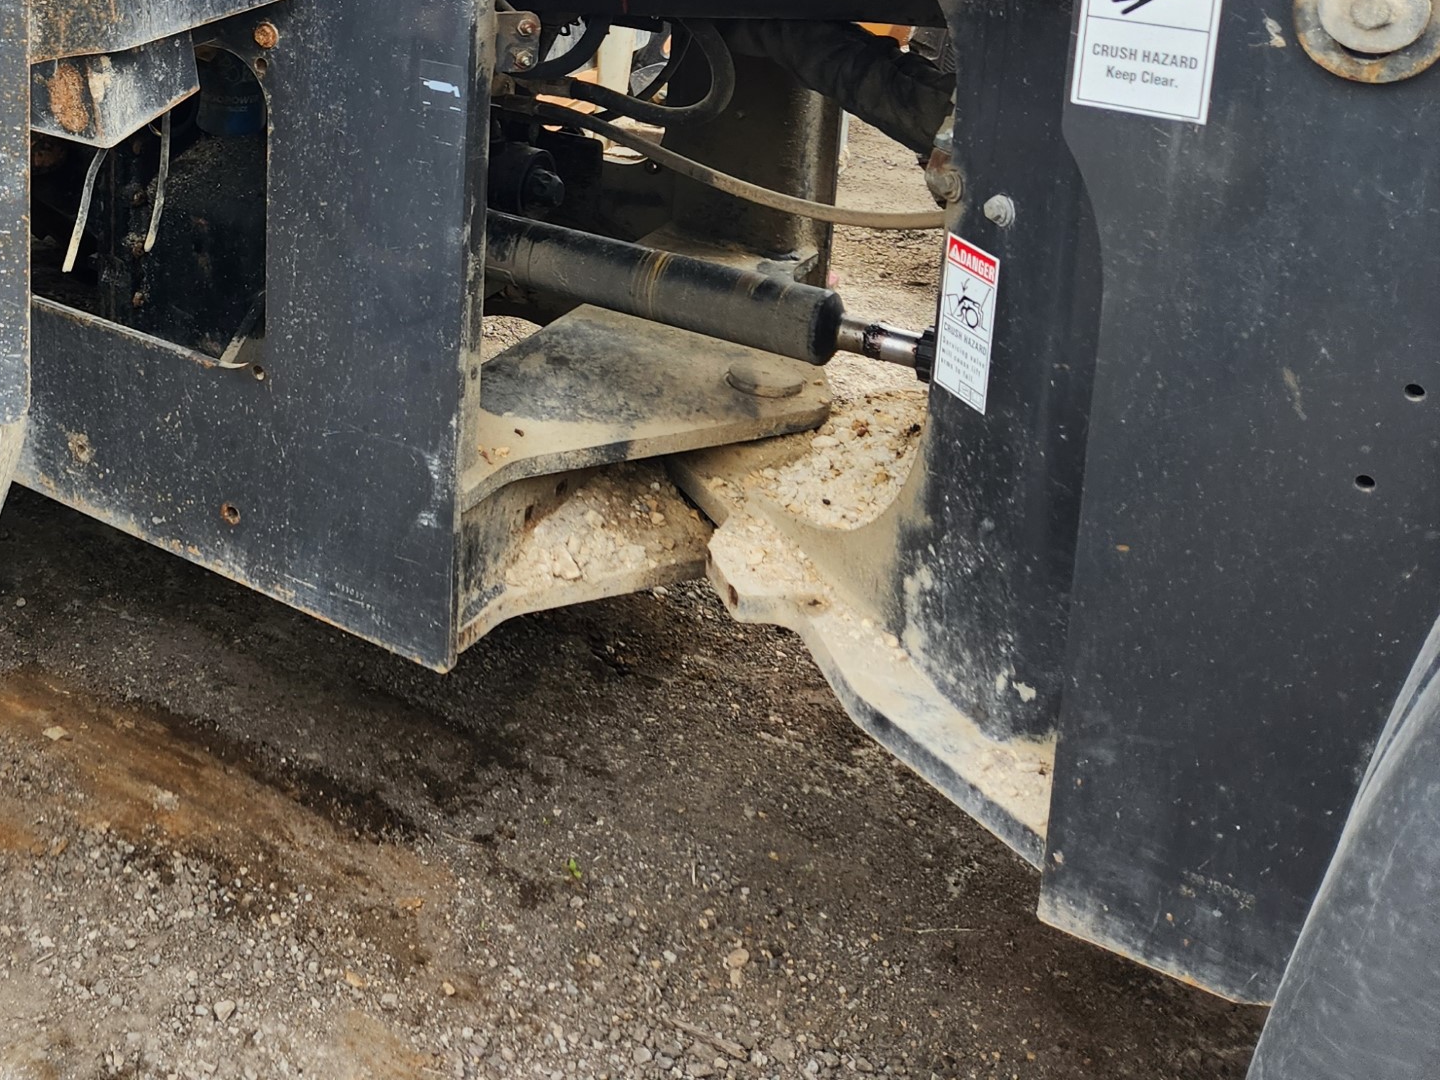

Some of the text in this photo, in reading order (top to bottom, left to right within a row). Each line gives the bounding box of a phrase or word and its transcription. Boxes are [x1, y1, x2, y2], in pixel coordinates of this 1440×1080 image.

[1092, 42, 1198, 70] CRUSH HAZARD
[1106, 65, 1179, 88] Keep Clear.
[960, 249, 996, 283] DANGER
[944, 321, 988, 357] CRUSH HAZARD
